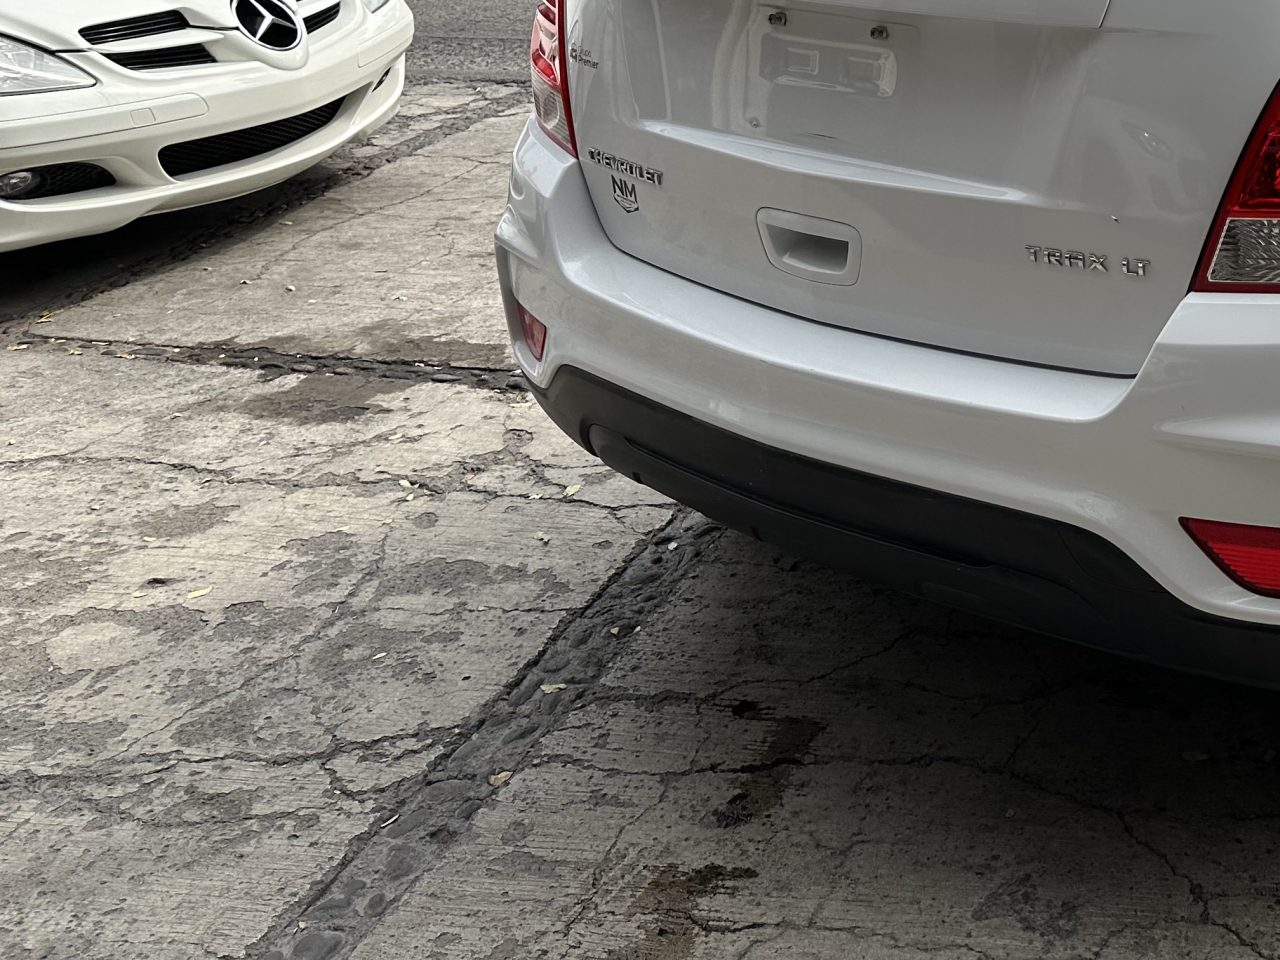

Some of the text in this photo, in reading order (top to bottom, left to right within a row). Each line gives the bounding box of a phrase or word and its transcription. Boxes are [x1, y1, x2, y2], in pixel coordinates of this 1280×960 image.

[588, 147, 664, 186] CHEVROLET
[611, 174, 638, 203] NM
[1025, 245, 1151, 276] TRAX LT
